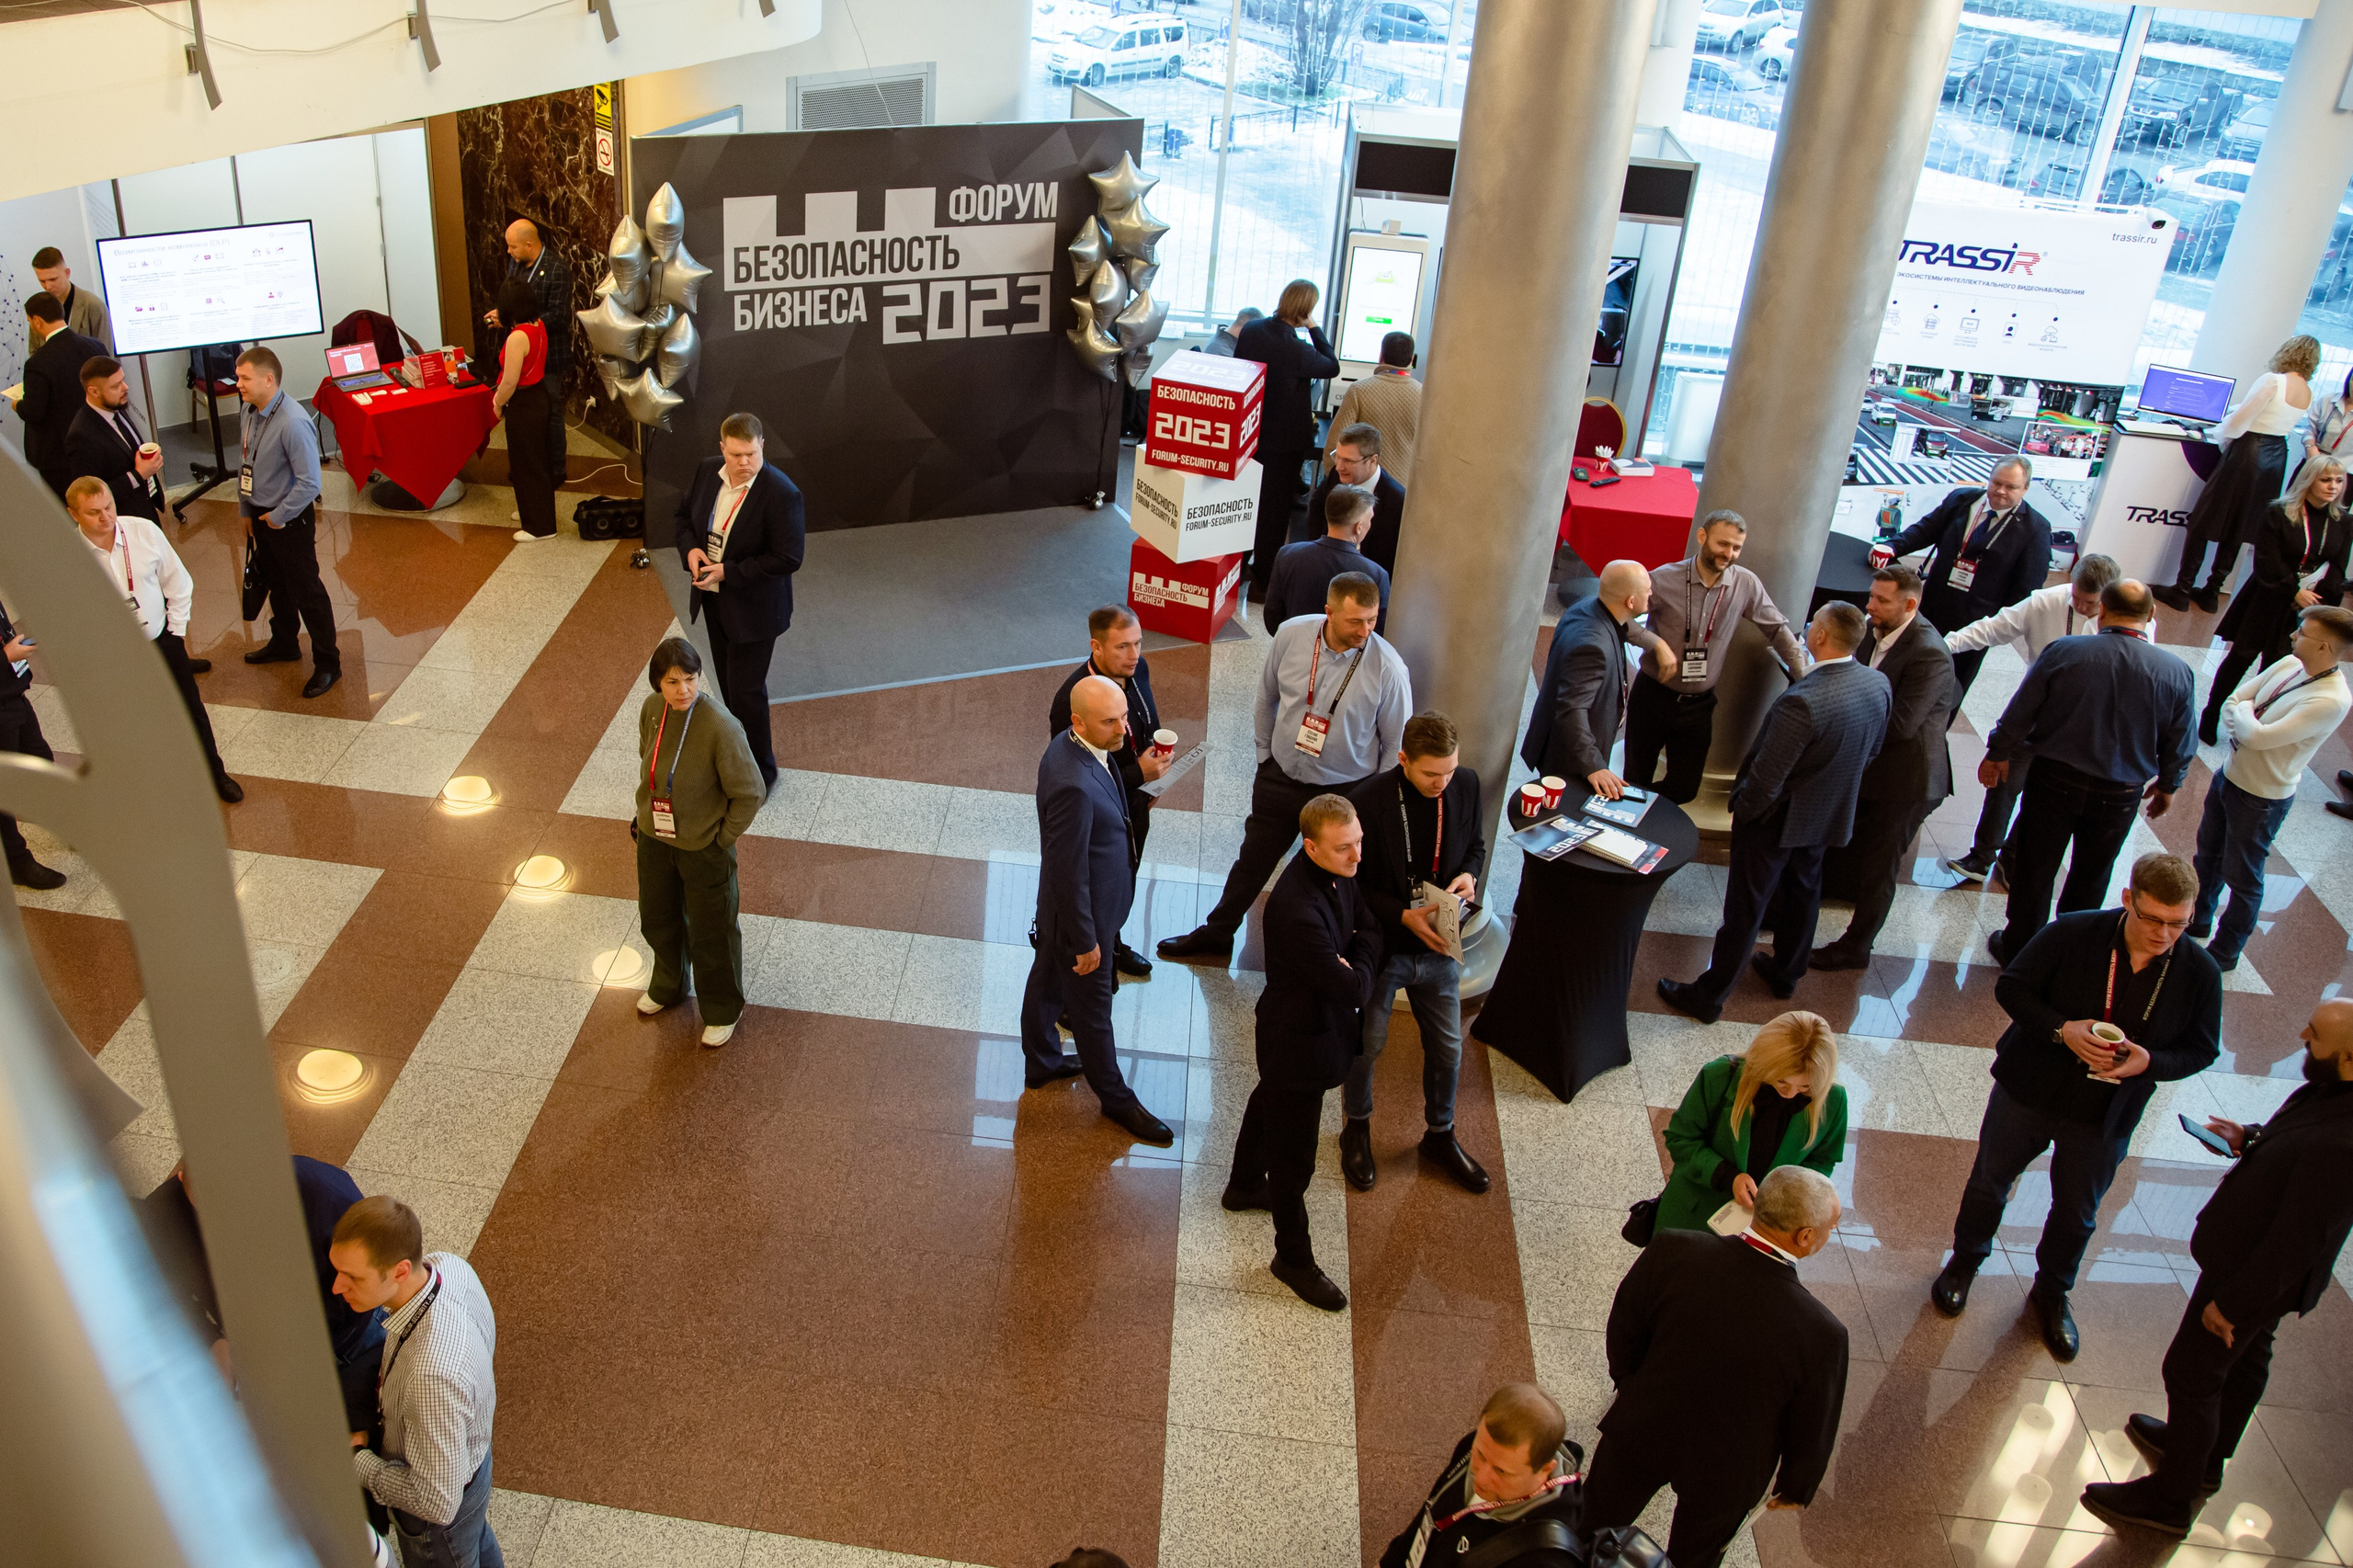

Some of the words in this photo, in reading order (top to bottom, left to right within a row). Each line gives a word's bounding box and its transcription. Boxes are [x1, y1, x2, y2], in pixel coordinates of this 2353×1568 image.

[949, 181, 1058, 222] ФОРУМ
[2112, 233, 2158, 244] trassir.ru
[733, 234, 960, 283] БЕЗОПАСНОСТЬ
[1897, 239, 2040, 276] TRASSIR
[1943, 277, 2016, 290] ИНТЕЛЛЕКТУАЛЬНОГО
[2017, 284, 2086, 296] ВИДЕОНАБЛЮДЕНИЯ
[734, 287, 868, 332] БИЗНЕСА
[882, 275, 1051, 345] 2023
[1157, 384, 1236, 411] БЕЗОПАСНОСТЬ
[1154, 412, 1231, 450] 2023
[1239, 400, 1262, 449] 2023
[1152, 449, 1230, 472] FORUM-SECURITY.RU
[1136, 478, 1178, 517] БЕЗОПАСНОСТЬ
[1187, 497, 1254, 519] БЕЗОПАСНОСТЬ
[1186, 512, 1252, 531] FORUM-SECURITY.RU
[1134, 582, 1188, 603] БЕЗОПАСНОСТЬ
[1134, 593, 1165, 608] БИЗНЕСА
[1181, 583, 1209, 596] ФОРУМ
[1547, 834, 1588, 853] 2023
